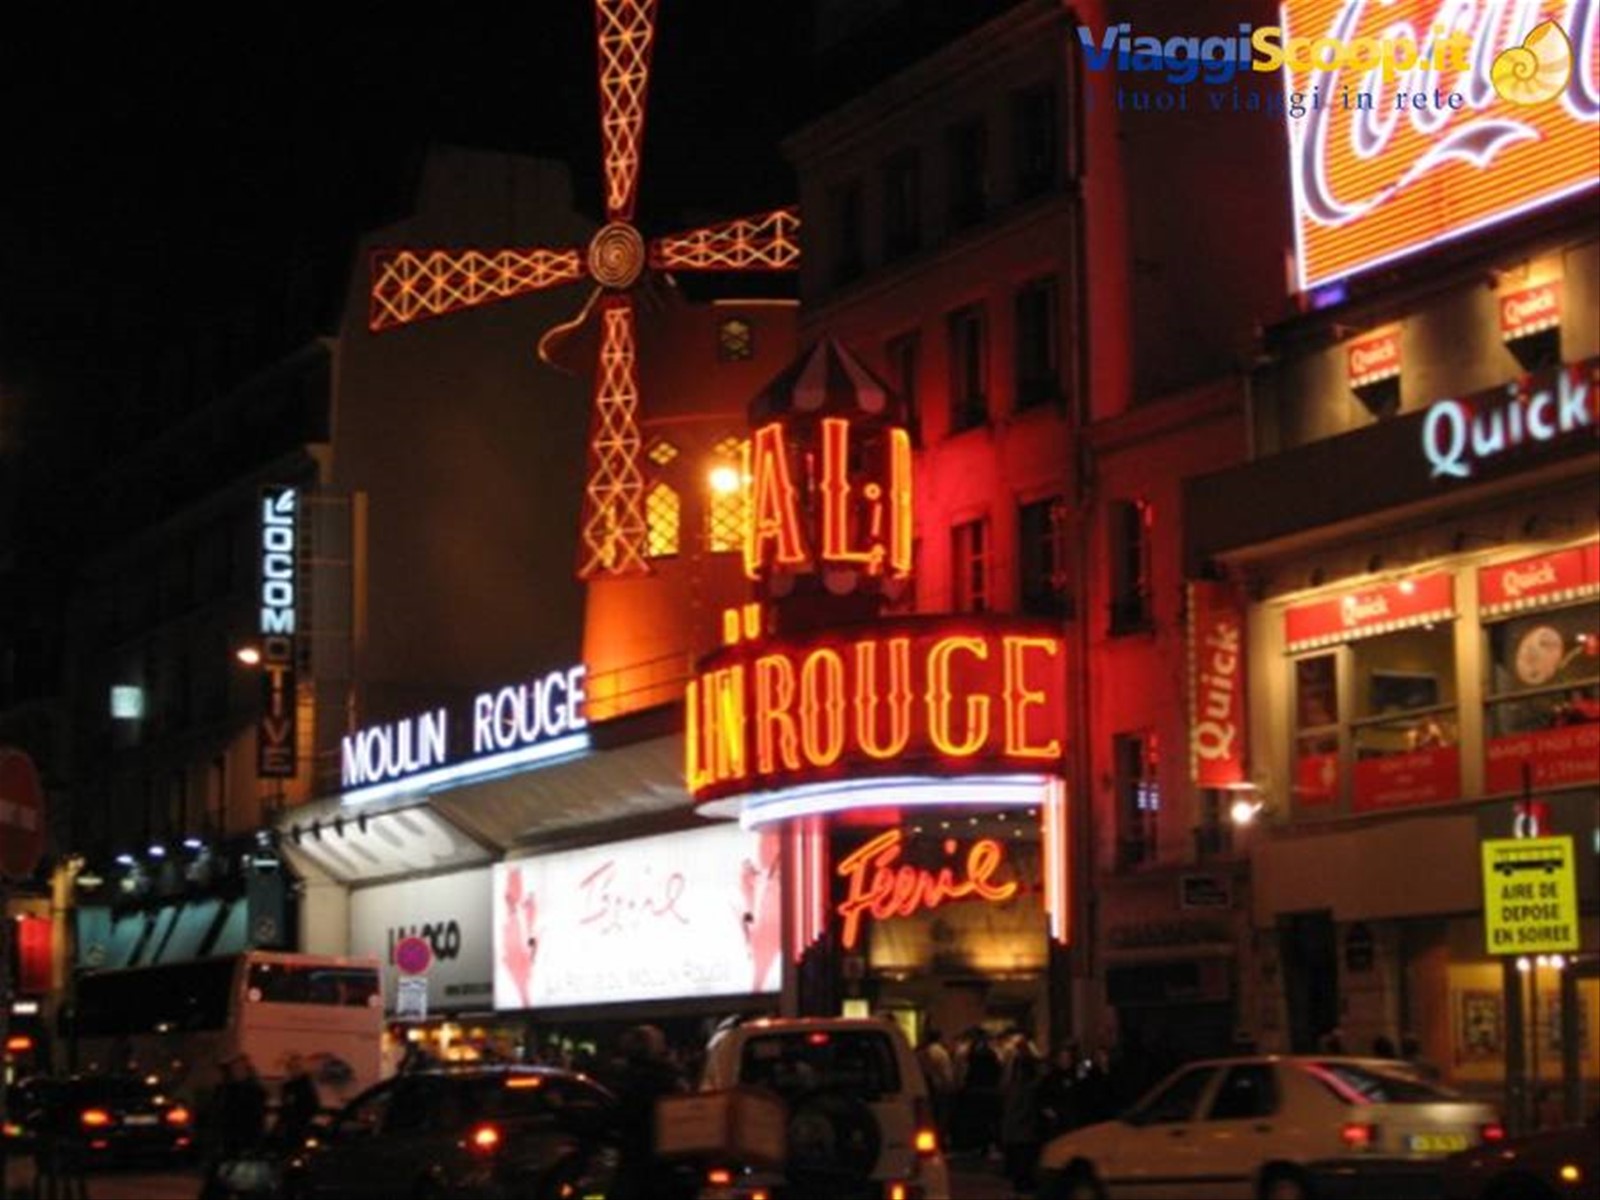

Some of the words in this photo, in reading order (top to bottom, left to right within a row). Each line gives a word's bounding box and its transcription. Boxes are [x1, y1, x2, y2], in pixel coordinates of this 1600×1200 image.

[1505, 291, 1554, 323] Quick
[1350, 340, 1396, 373] Quick
[1422, 370, 1591, 477] Quick
[1502, 562, 1556, 596] Quick
[755, 636, 1062, 774] ROUGE
[1197, 622, 1240, 760] Quick
[341, 708, 447, 786] MOULIN
[474, 665, 587, 753] ROUGE
[1539, 881, 1557, 899] DE
[1494, 928, 1513, 945] EN
